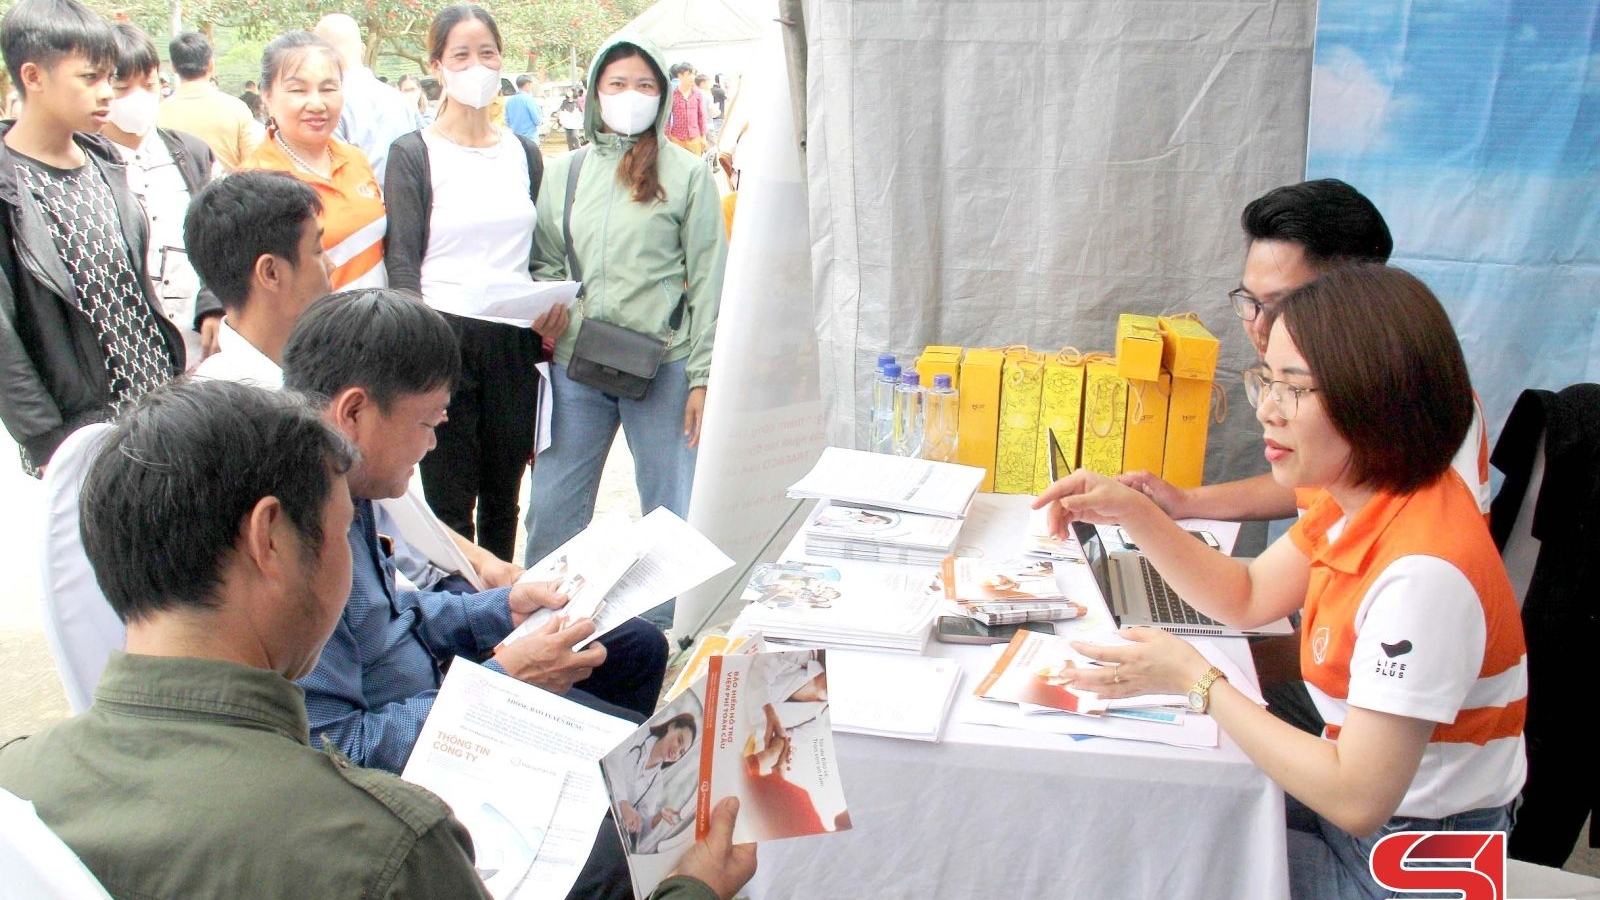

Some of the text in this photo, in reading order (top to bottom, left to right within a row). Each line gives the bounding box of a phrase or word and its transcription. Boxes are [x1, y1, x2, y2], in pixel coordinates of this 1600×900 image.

[1375, 667, 1404, 679] PLUS
[1377, 659, 1407, 671] LIFE
[433, 740, 479, 763] CÔNG TY
[438, 730, 472, 750] THÔNG
[475, 743, 491, 756] TIN
